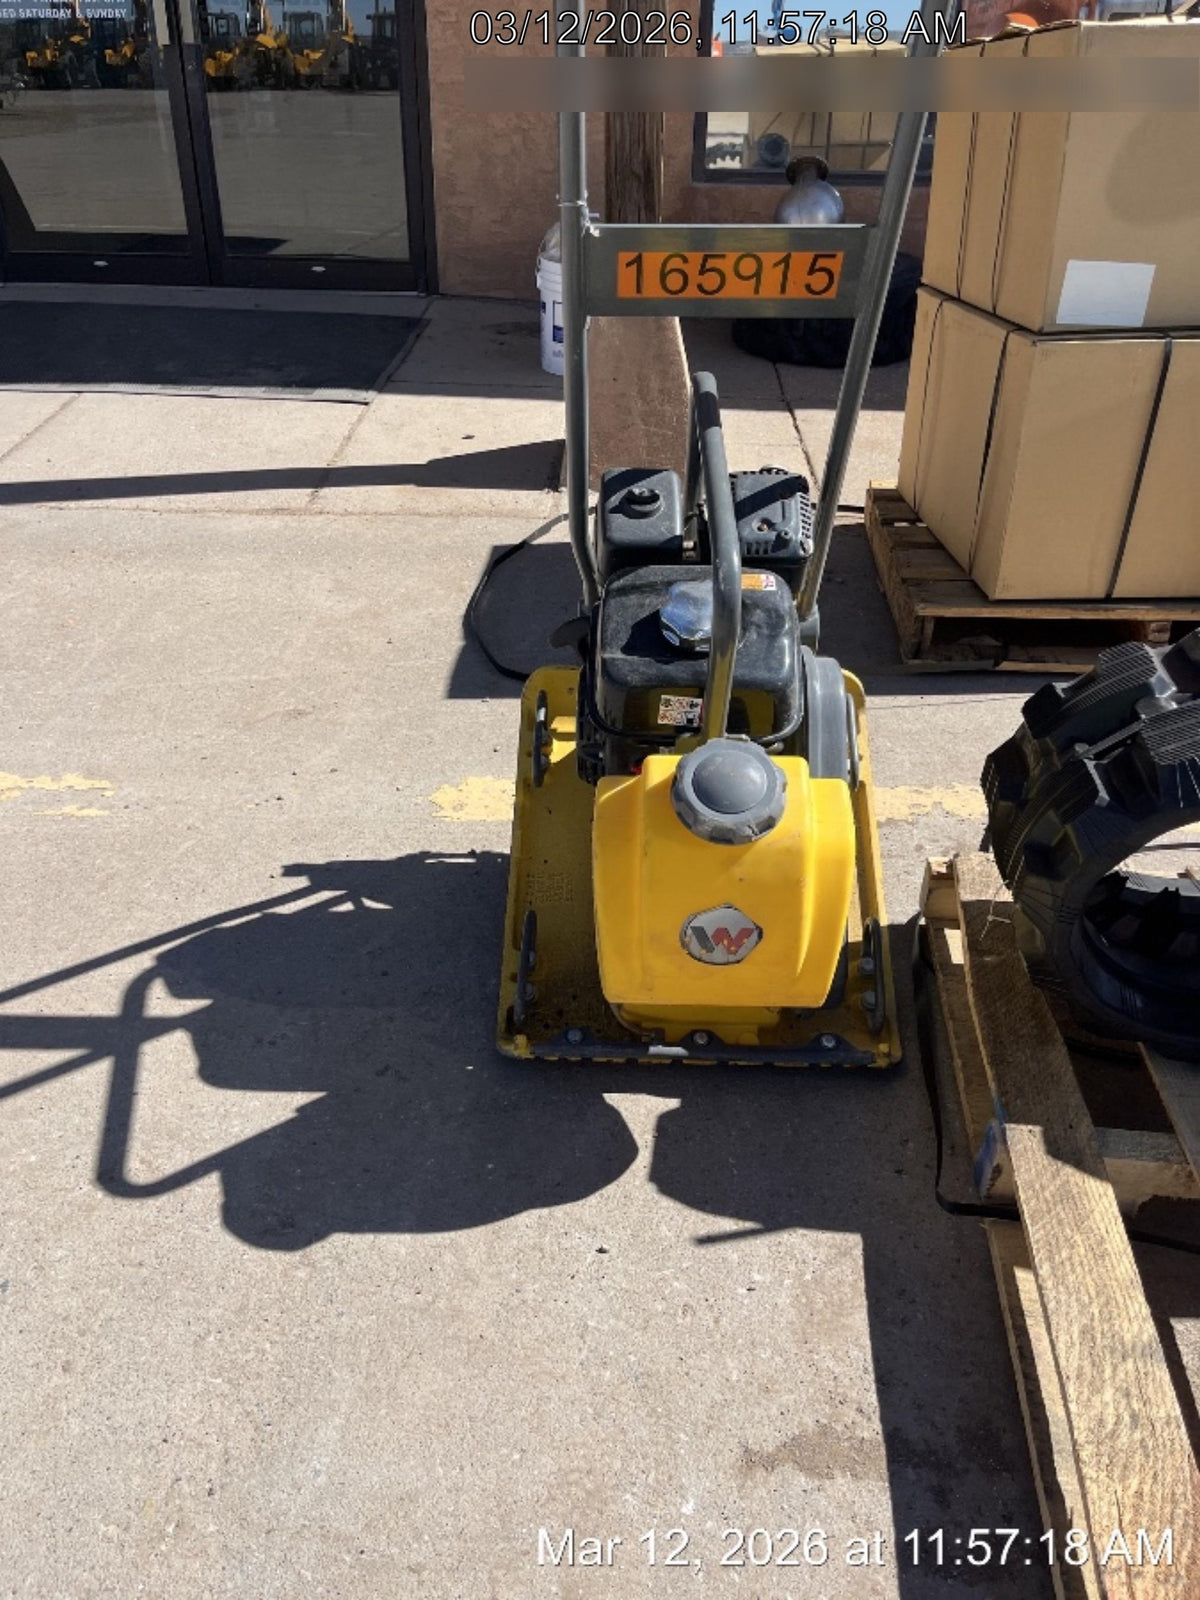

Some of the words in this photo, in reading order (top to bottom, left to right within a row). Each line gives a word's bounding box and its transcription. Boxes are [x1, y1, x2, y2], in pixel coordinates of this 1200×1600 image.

[0, 8, 16, 18] ED
[18, 8, 71, 18] SATURDAY
[86, 8, 127, 18] SUNDAY
[624, 252, 838, 296] 165915
